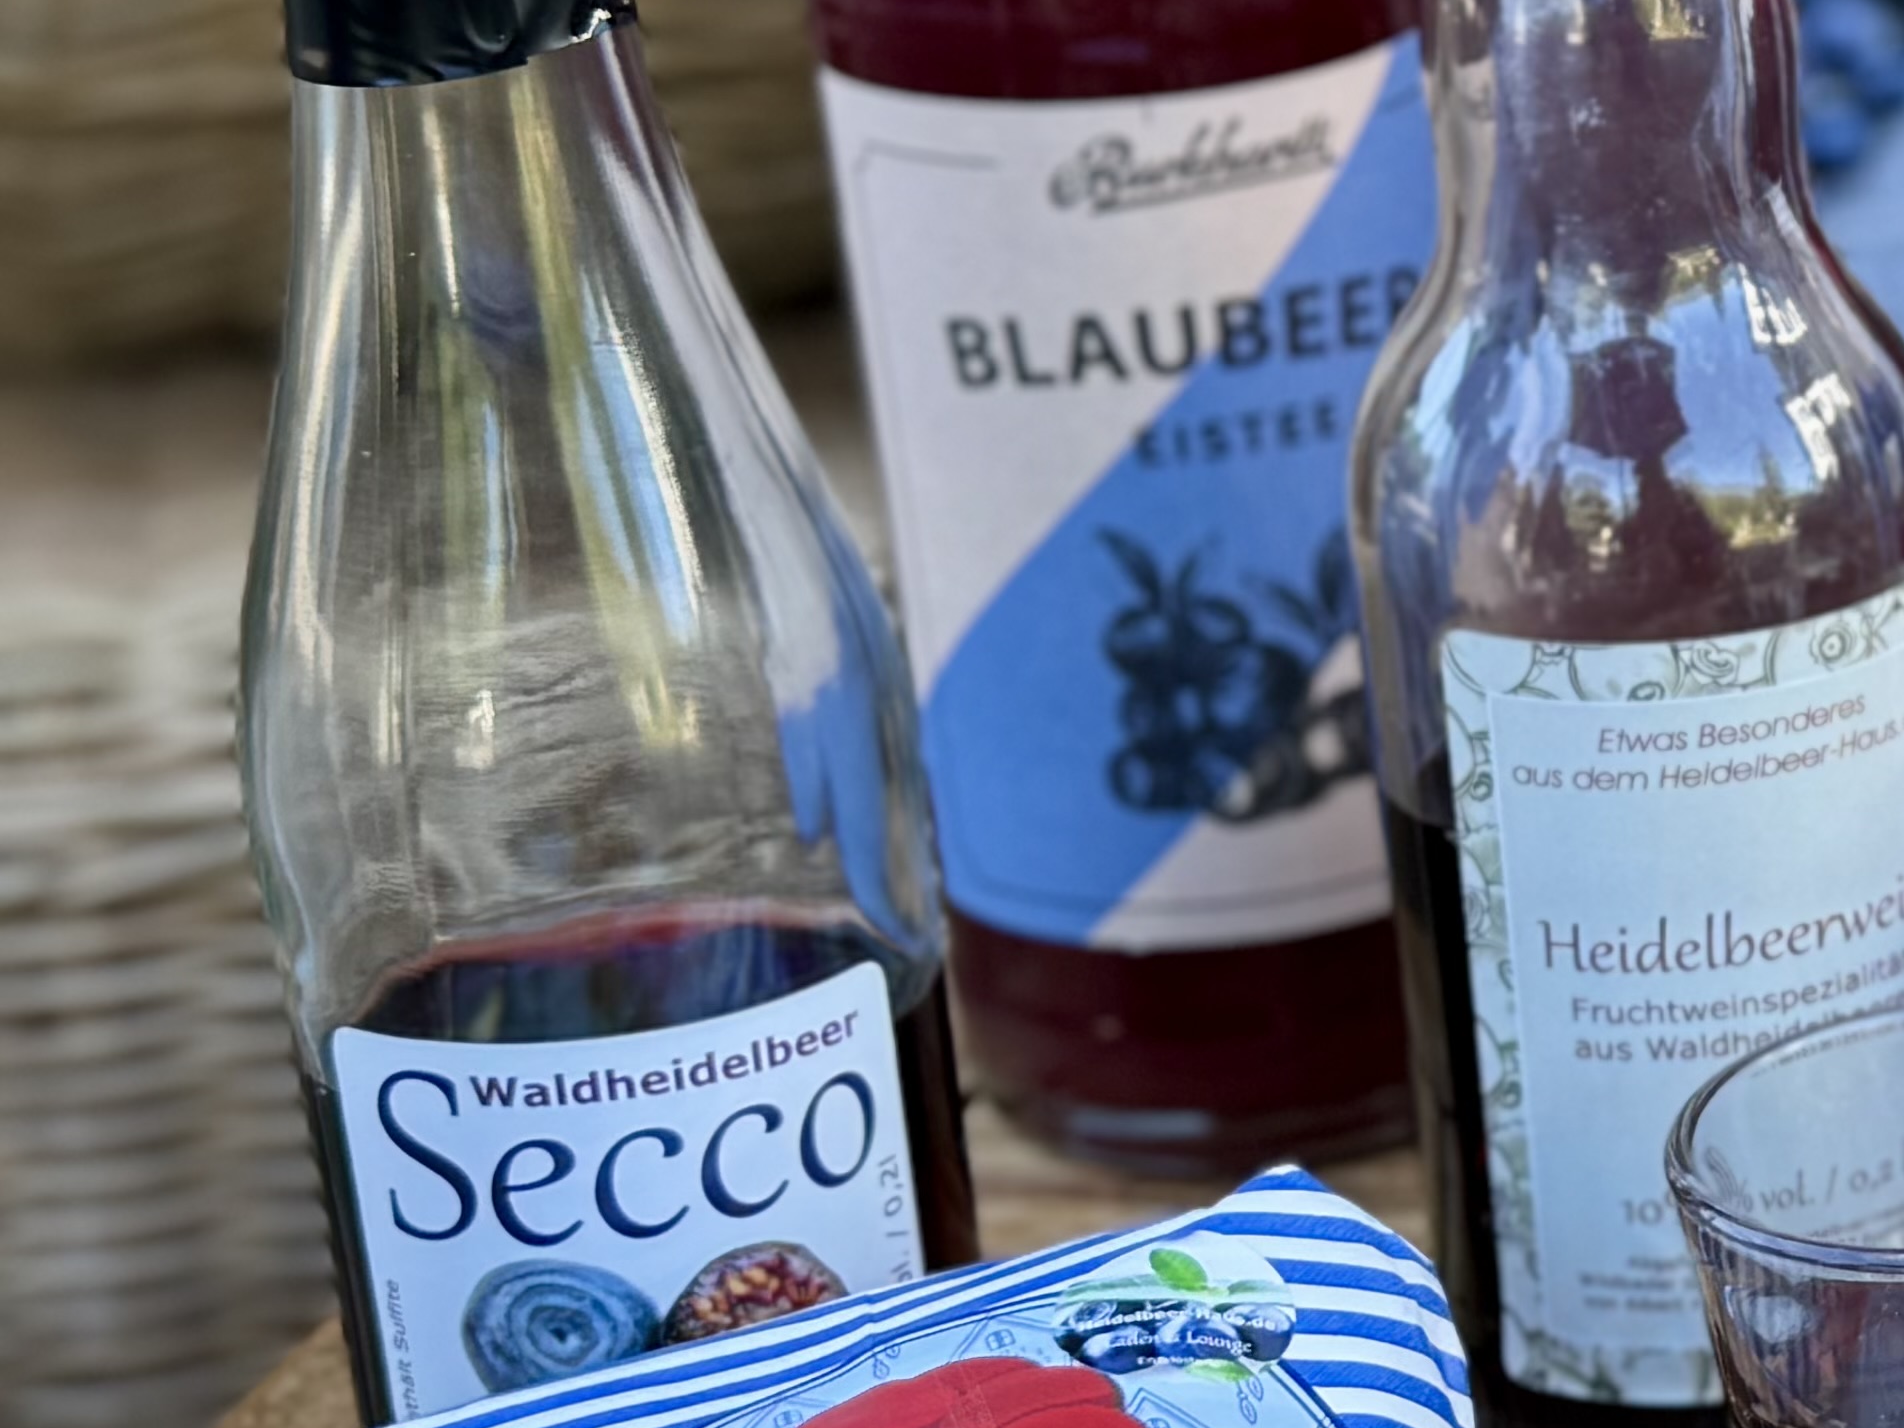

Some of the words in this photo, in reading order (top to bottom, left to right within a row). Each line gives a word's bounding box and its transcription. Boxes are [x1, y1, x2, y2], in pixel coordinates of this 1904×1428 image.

[1133, 398, 1339, 470] EISTEE
[1598, 726, 1688, 754] Etwas
[1697, 692, 1865, 750] Besonderes
[1512, 763, 1563, 789] aus
[1573, 758, 1648, 791] dem
[469, 1009, 860, 1110] Waldheidelbeer
[1575, 1037, 1633, 1062] aus
[376, 1069, 876, 1247] Secco
